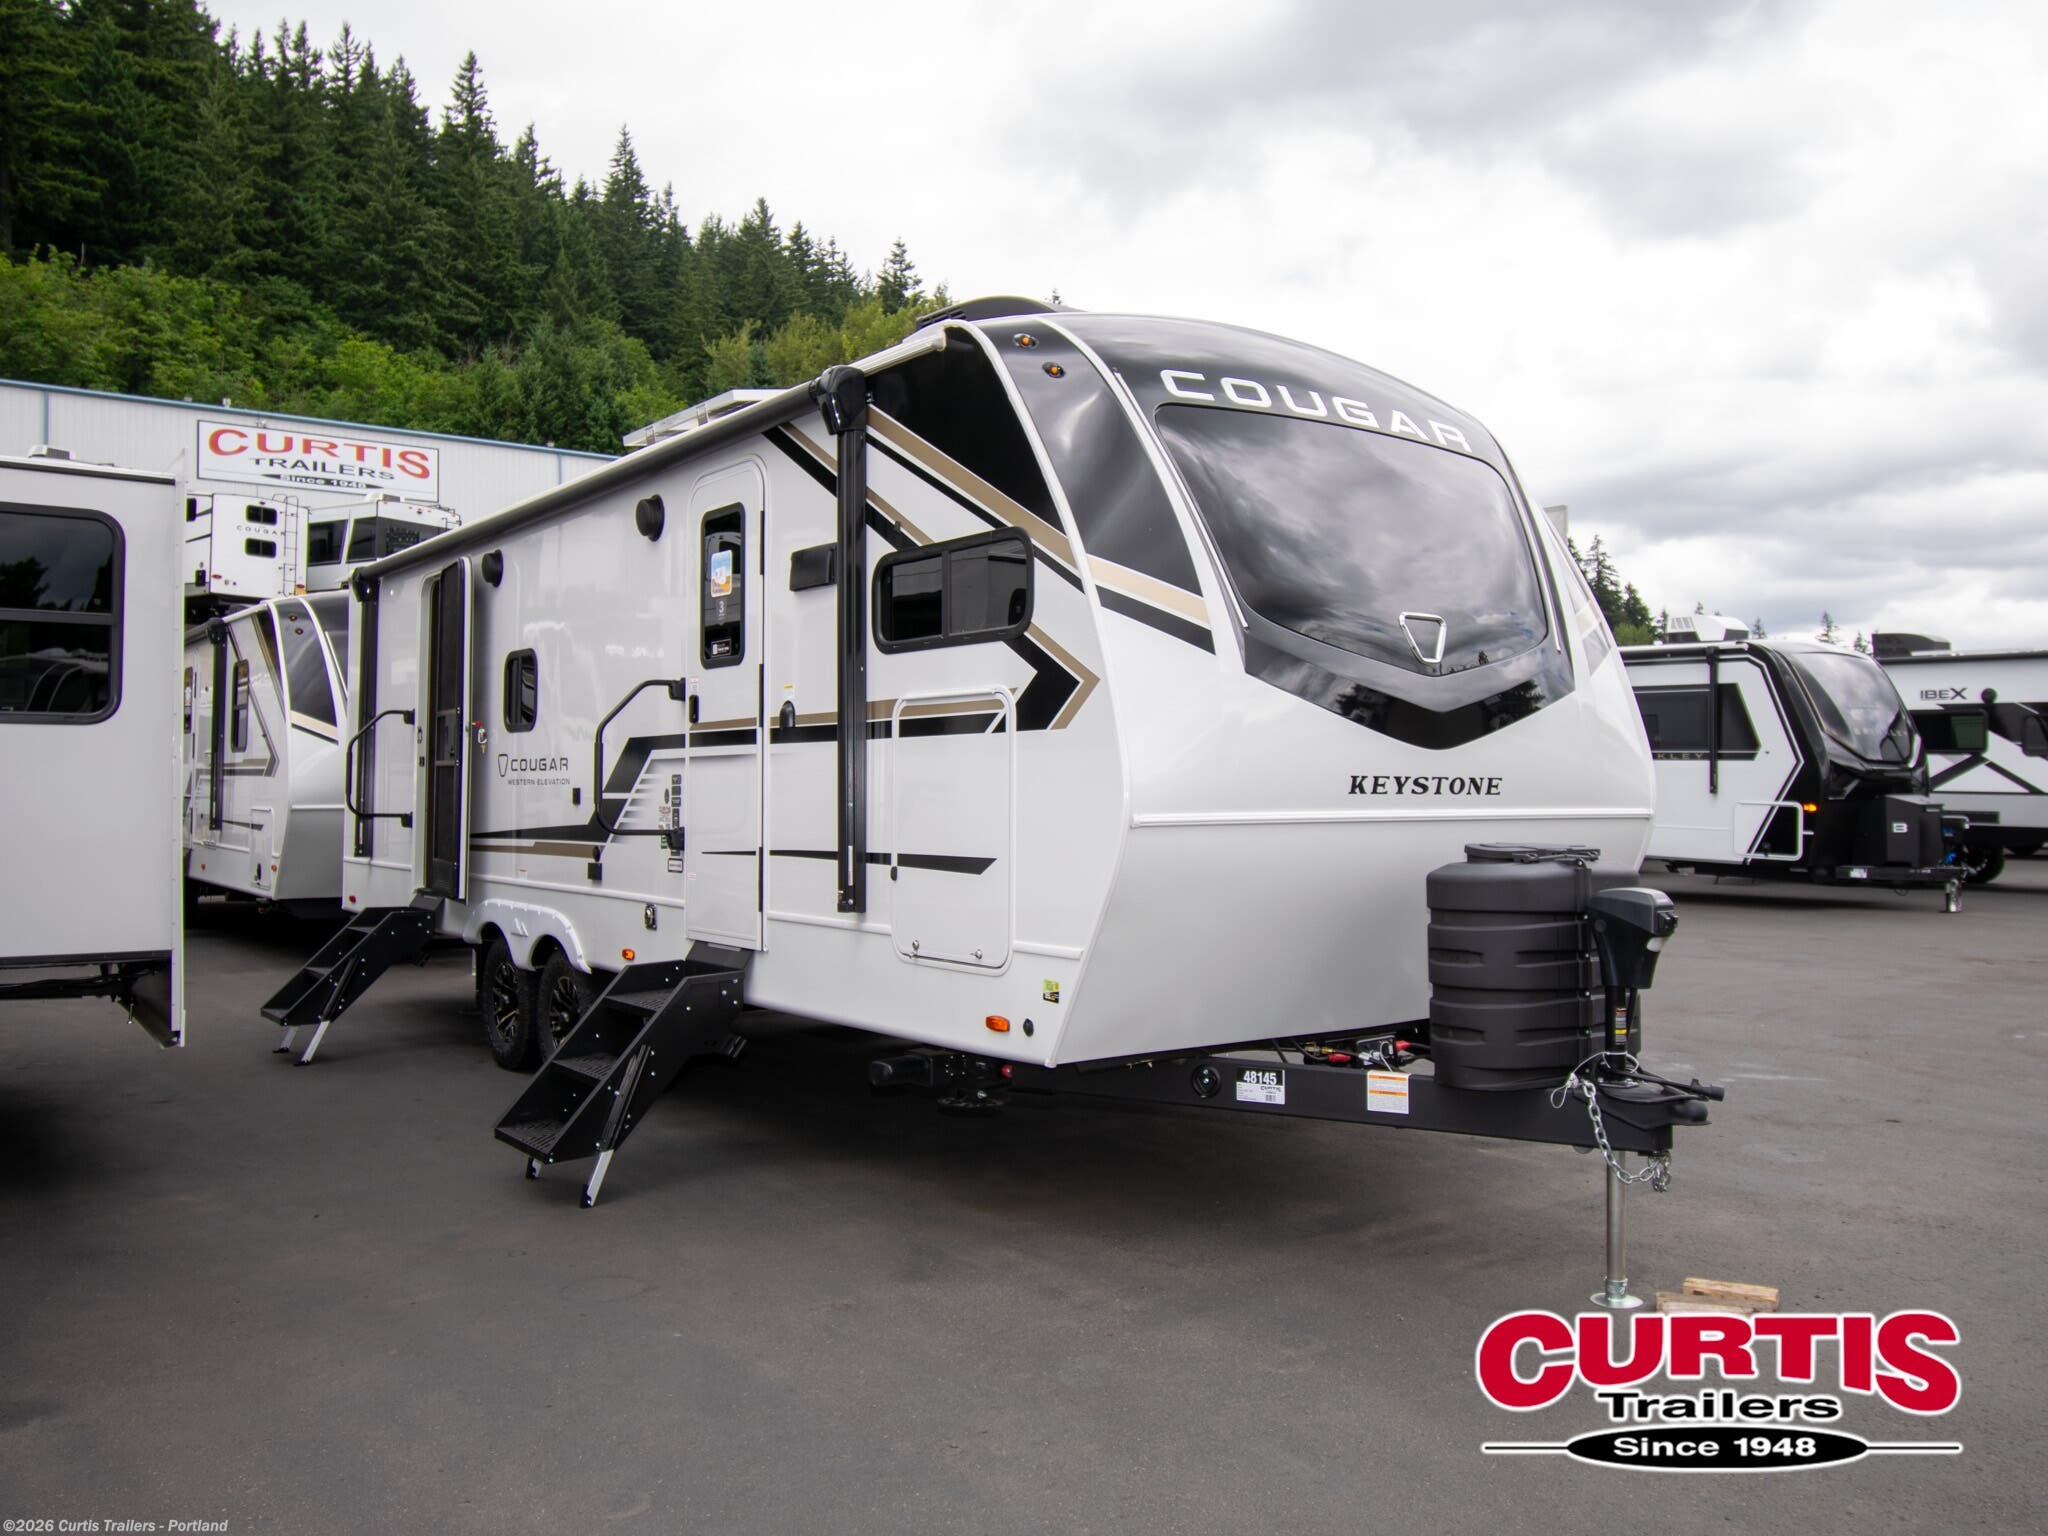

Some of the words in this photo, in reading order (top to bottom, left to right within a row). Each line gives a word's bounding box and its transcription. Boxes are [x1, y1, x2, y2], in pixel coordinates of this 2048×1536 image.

[1160, 369, 1472, 453] COUGAR
[208, 428, 430, 479] CURTIS
[249, 457, 394, 480] TRAILERS
[1920, 688, 1967, 700] IBEX
[511, 757, 568, 771] COUGAR
[1657, 752, 1703, 760] KLEY
[1348, 775, 1503, 796] KEYSTONE
[1243, 1070, 1277, 1085] 48145
